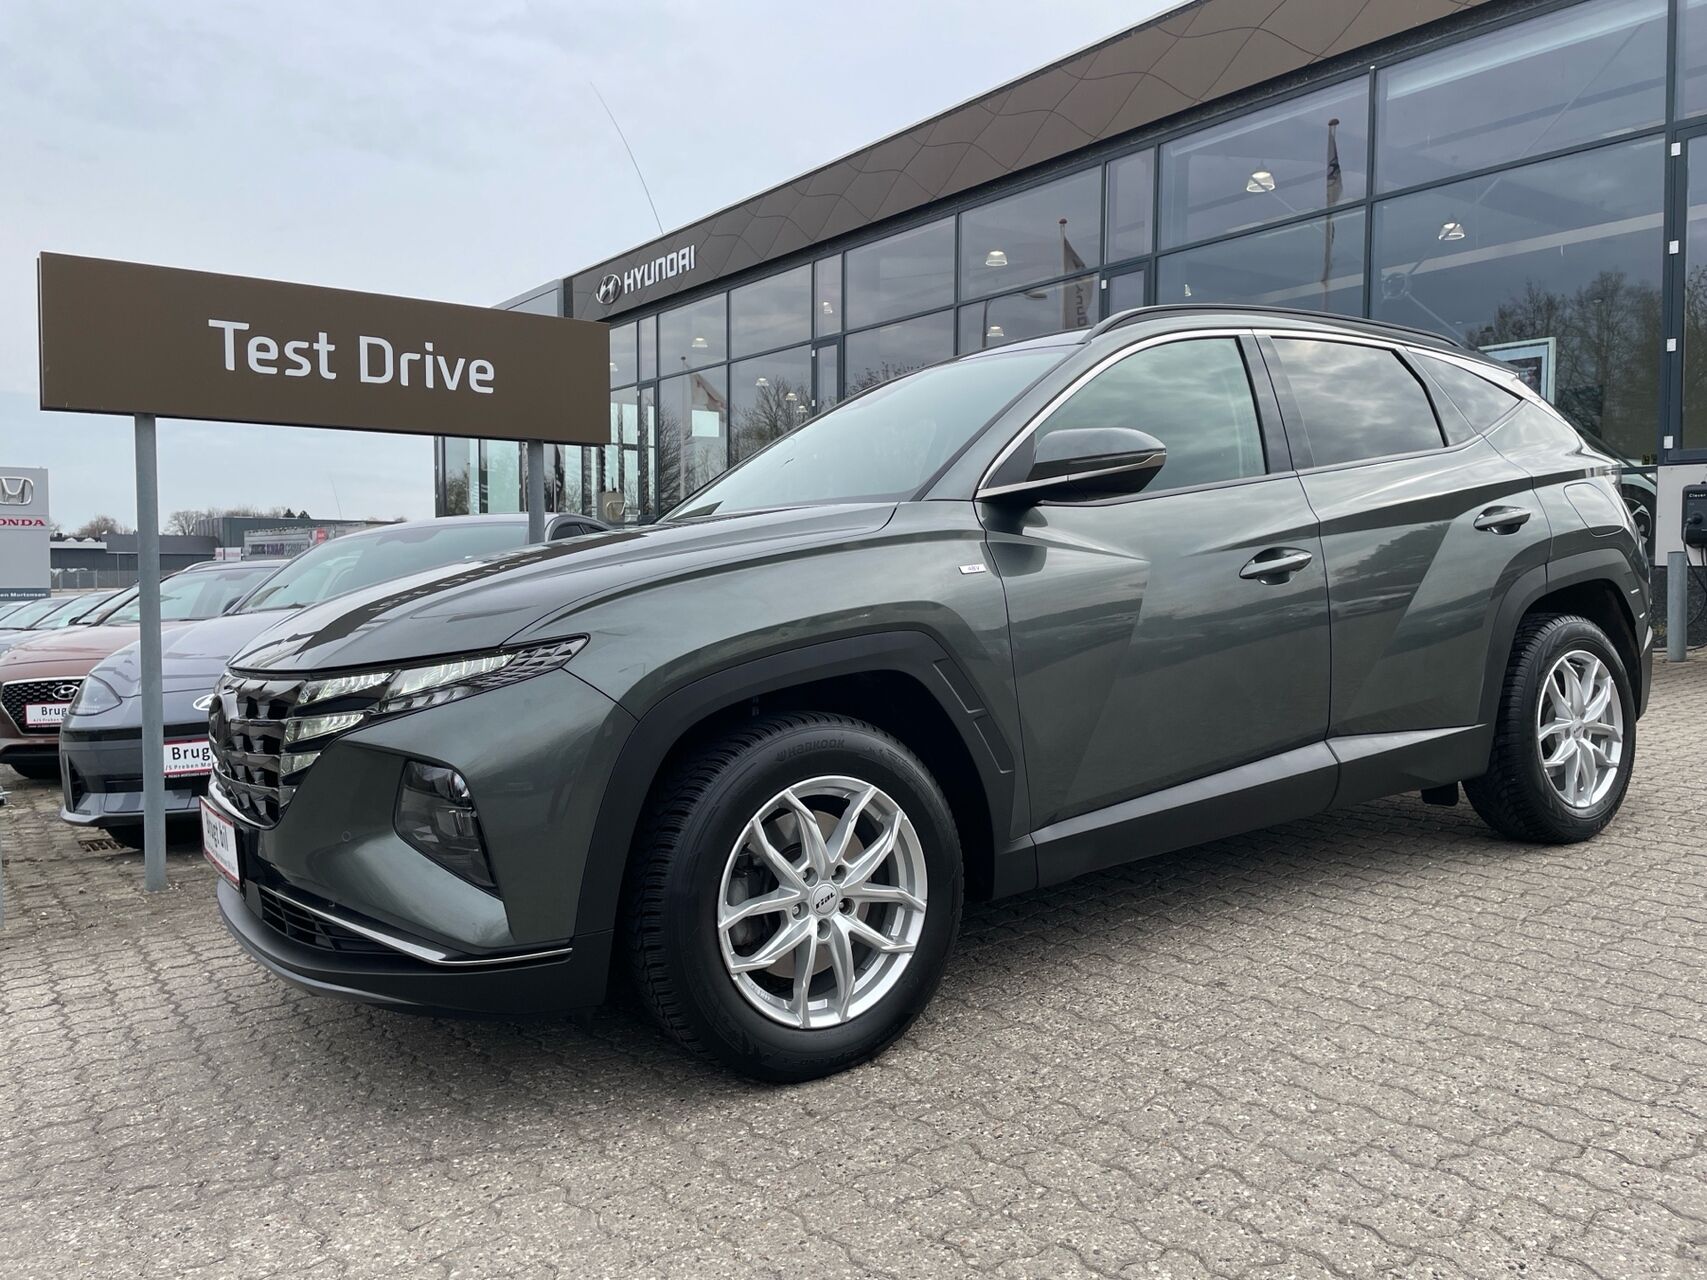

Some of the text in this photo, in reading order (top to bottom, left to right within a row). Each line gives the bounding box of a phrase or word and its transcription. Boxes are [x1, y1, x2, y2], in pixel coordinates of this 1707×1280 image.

[623, 244, 695, 294] HYUNDAI
[207, 318, 496, 394] Test Drive
[41, 706, 68, 718] Brug
[171, 746, 211, 761] Brug
